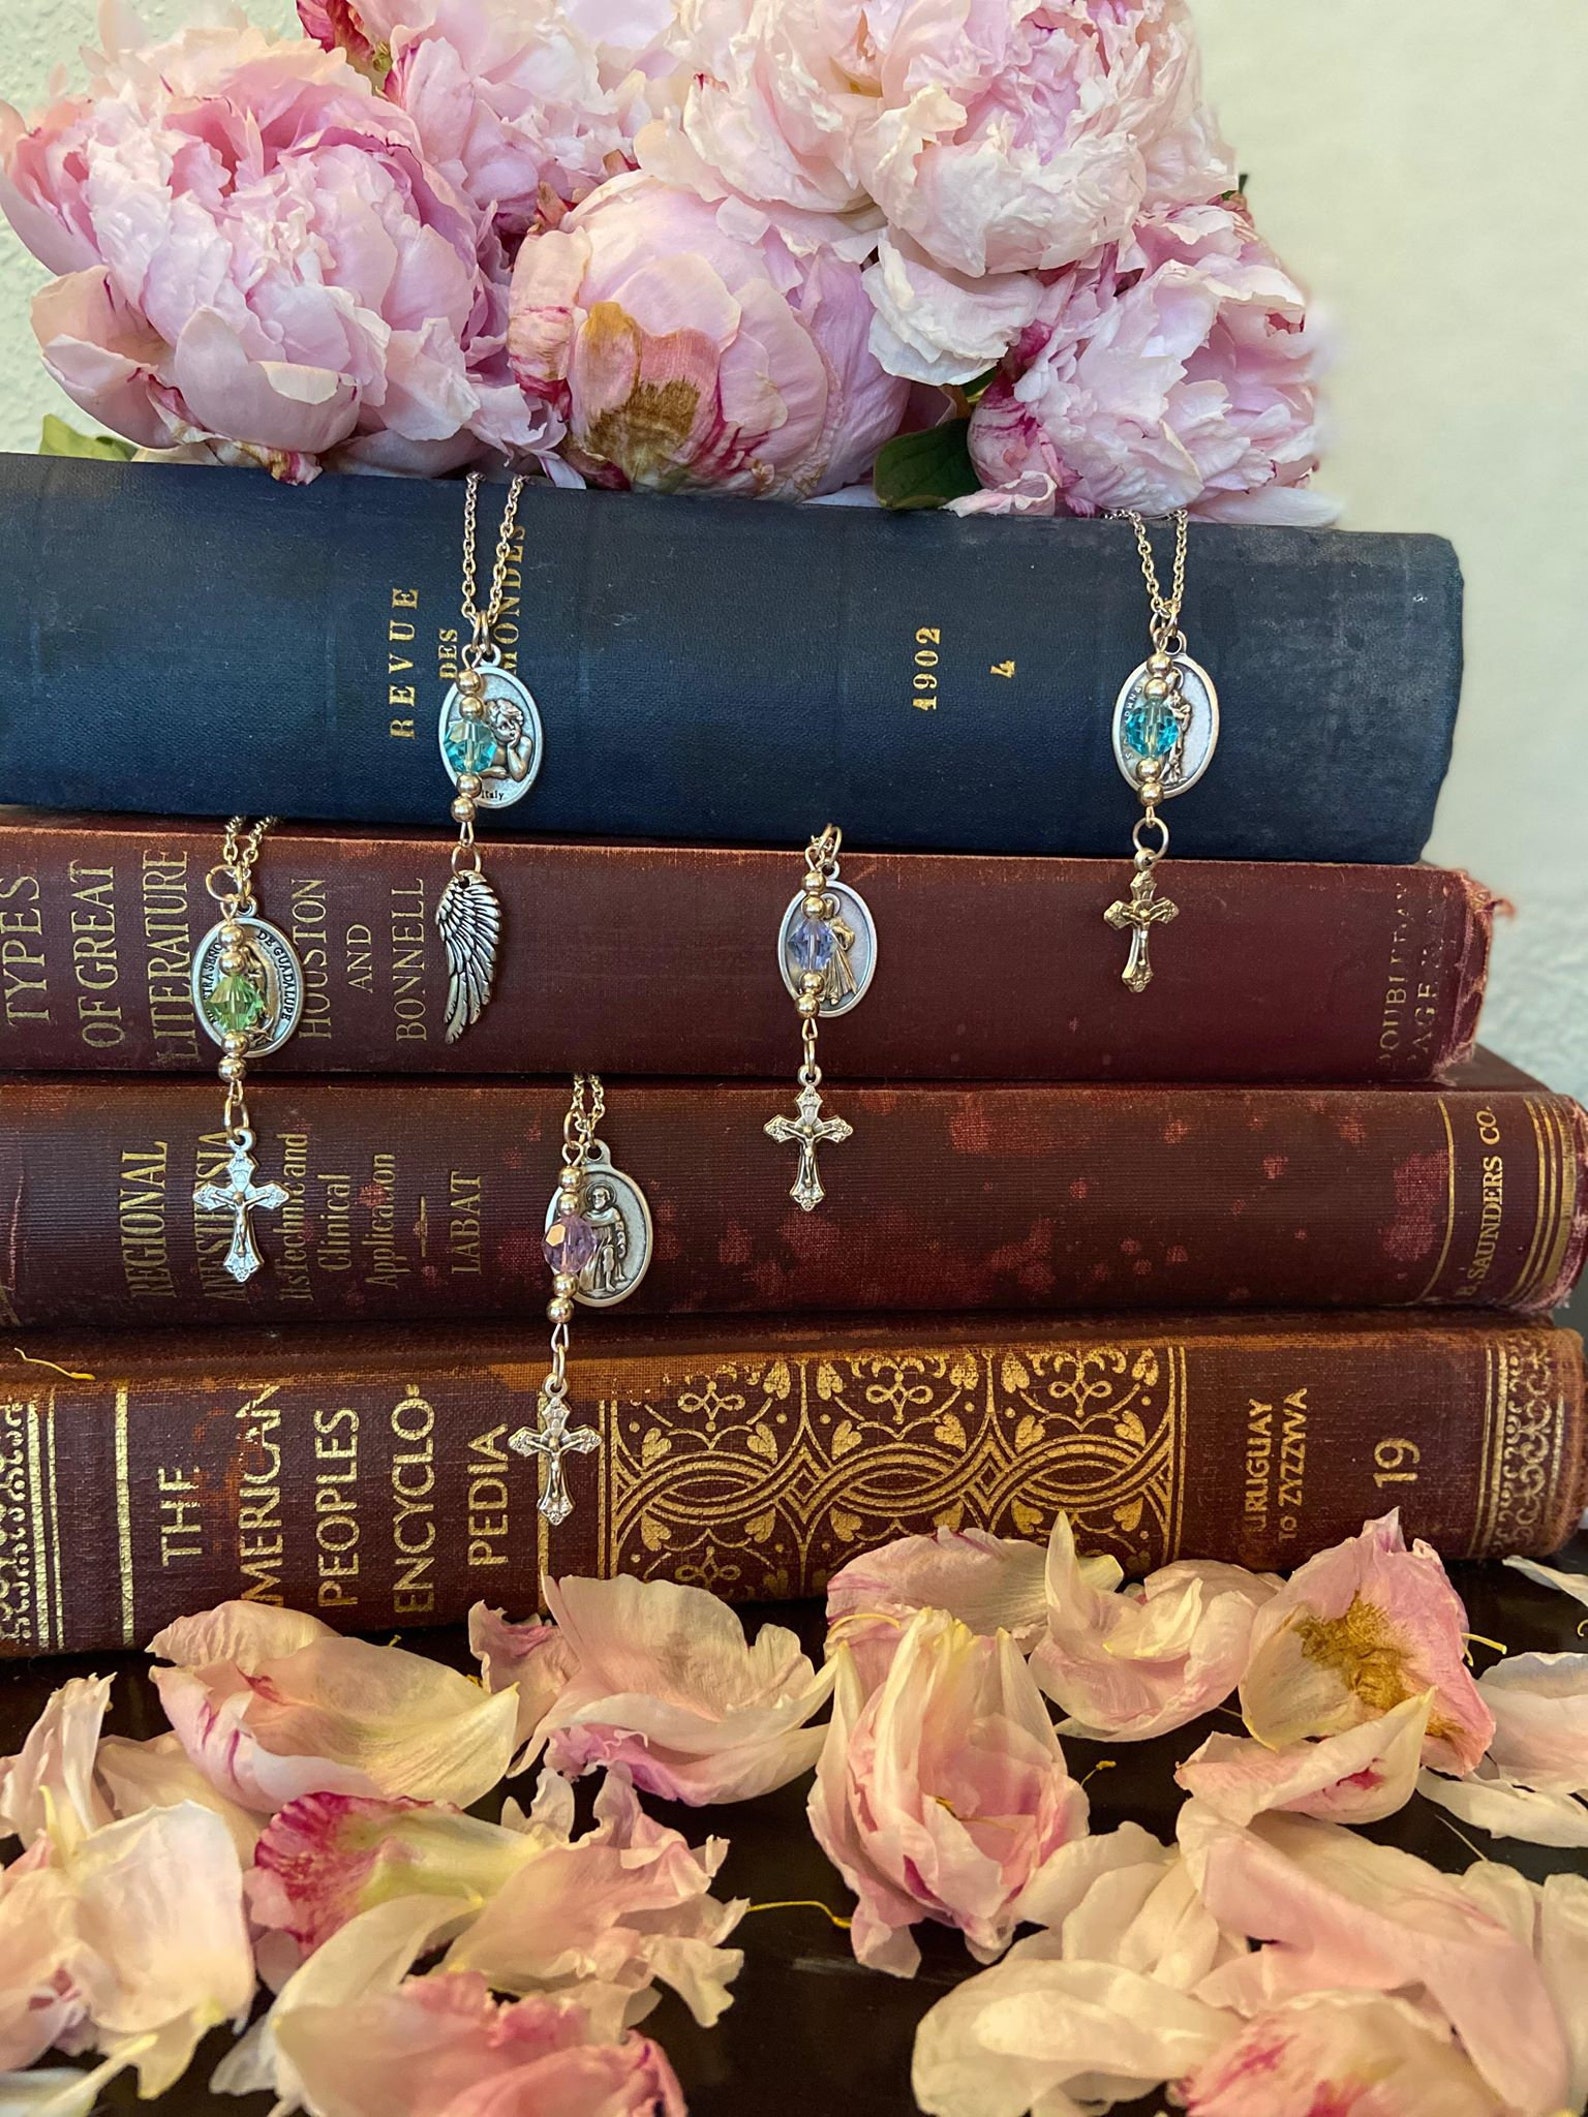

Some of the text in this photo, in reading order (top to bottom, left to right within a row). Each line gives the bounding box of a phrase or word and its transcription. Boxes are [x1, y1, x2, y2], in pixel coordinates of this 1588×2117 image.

[388, 587, 419, 739] REVUE
[438, 628, 458, 681] DES
[912, 626, 941, 711] 1902
[989, 659, 1017, 679] 4
[0, 875, 51, 1028] TYPES
[69, 858, 126, 1049] OF GREAT
[142, 849, 200, 1064] LITERATURE
[256, 930, 296, 1021] DE GUADALUPE
[291, 878, 332, 1040] HOUSTON
[346, 923, 374, 994] AND
[391, 878, 427, 1042] BONNELL
[275, 1132, 309, 1178] and
[1479, 1105, 1500, 1146] CO.
[119, 1140, 178, 1299] REGIONAL
[193, 1130, 248, 1302] ANESTHSIA
[317, 1173, 353, 1272] Clinical
[361, 1152, 411, 1290] Applicaon
[450, 1169, 482, 1276] LABAT
[1472, 1155, 1503, 1280] SAUNDERS
[234, 1382, 284, 1608] MERICAN
[313, 1407, 360, 1607] PEOPLES
[466, 1423, 509, 1566] PEDIA
[1240, 1398, 1274, 1533] URUGUAY
[1277, 1387, 1308, 1542] TO ZYZZYVA
[1372, 1437, 1421, 1489] 19
